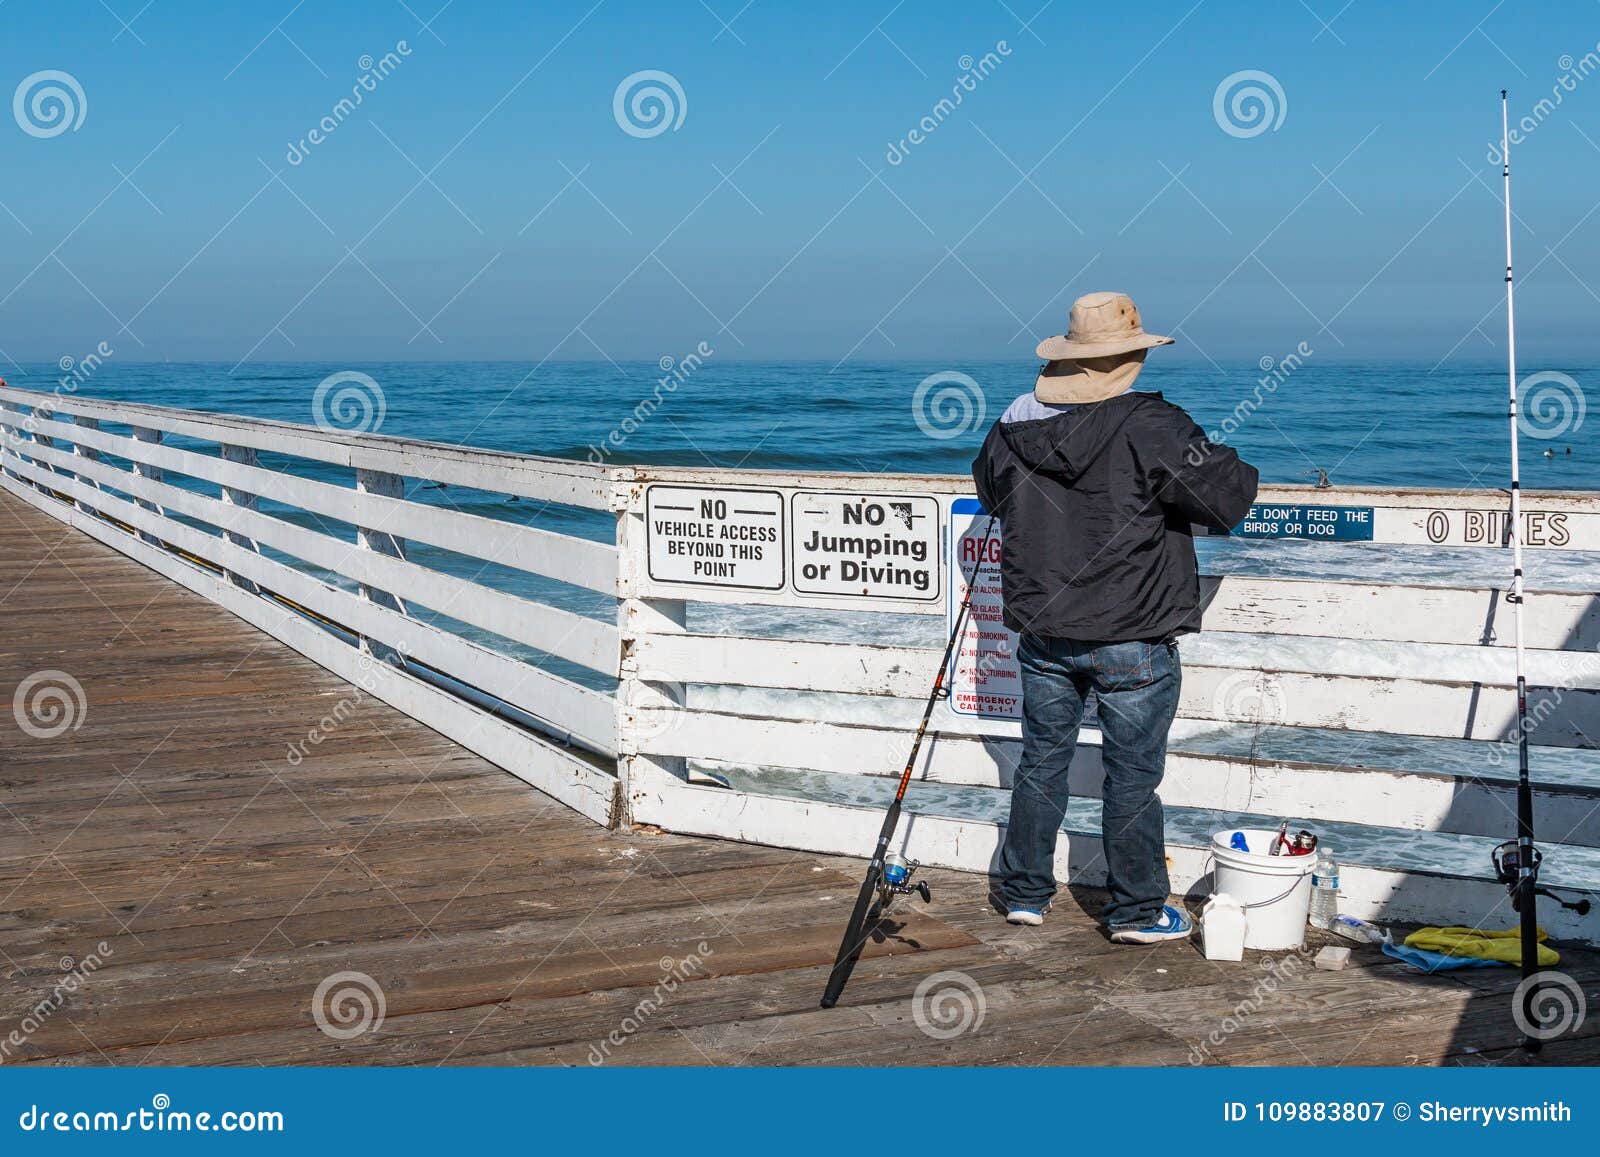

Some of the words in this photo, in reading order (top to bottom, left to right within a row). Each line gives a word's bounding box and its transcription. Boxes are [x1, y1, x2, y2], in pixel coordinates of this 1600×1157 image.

[700, 499, 727, 520] NO
[842, 503, 886, 526] NO
[1263, 508, 1301, 520] DON'T
[1307, 509, 1338, 522] FEED
[1345, 511, 1369, 523] THE
[654, 520, 714, 539] VEHICLE
[719, 524, 777, 543] ACCESS
[1243, 522, 1279, 534] BIRDS
[1284, 523, 1303, 534] OR
[1308, 524, 1336, 536] DOG
[667, 540, 724, 558] BEYOND
[729, 544, 763, 561] THIS
[803, 530, 928, 562] Jumping
[962, 537, 1003, 564] REG
[693, 560, 737, 578] POINT
[802, 563, 831, 580] or
[840, 560, 930, 591] Diving
[980, 604, 1001, 613] GLASS
[969, 631, 978, 640] NO
[980, 631, 1009, 641] SMOKING
[969, 649, 977, 657] NO
[969, 668, 977, 677] NO
[956, 694, 1018, 706] EMERGENCY
[959, 702, 984, 712] CALL
[988, 704, 1014, 713] 9-1-1
